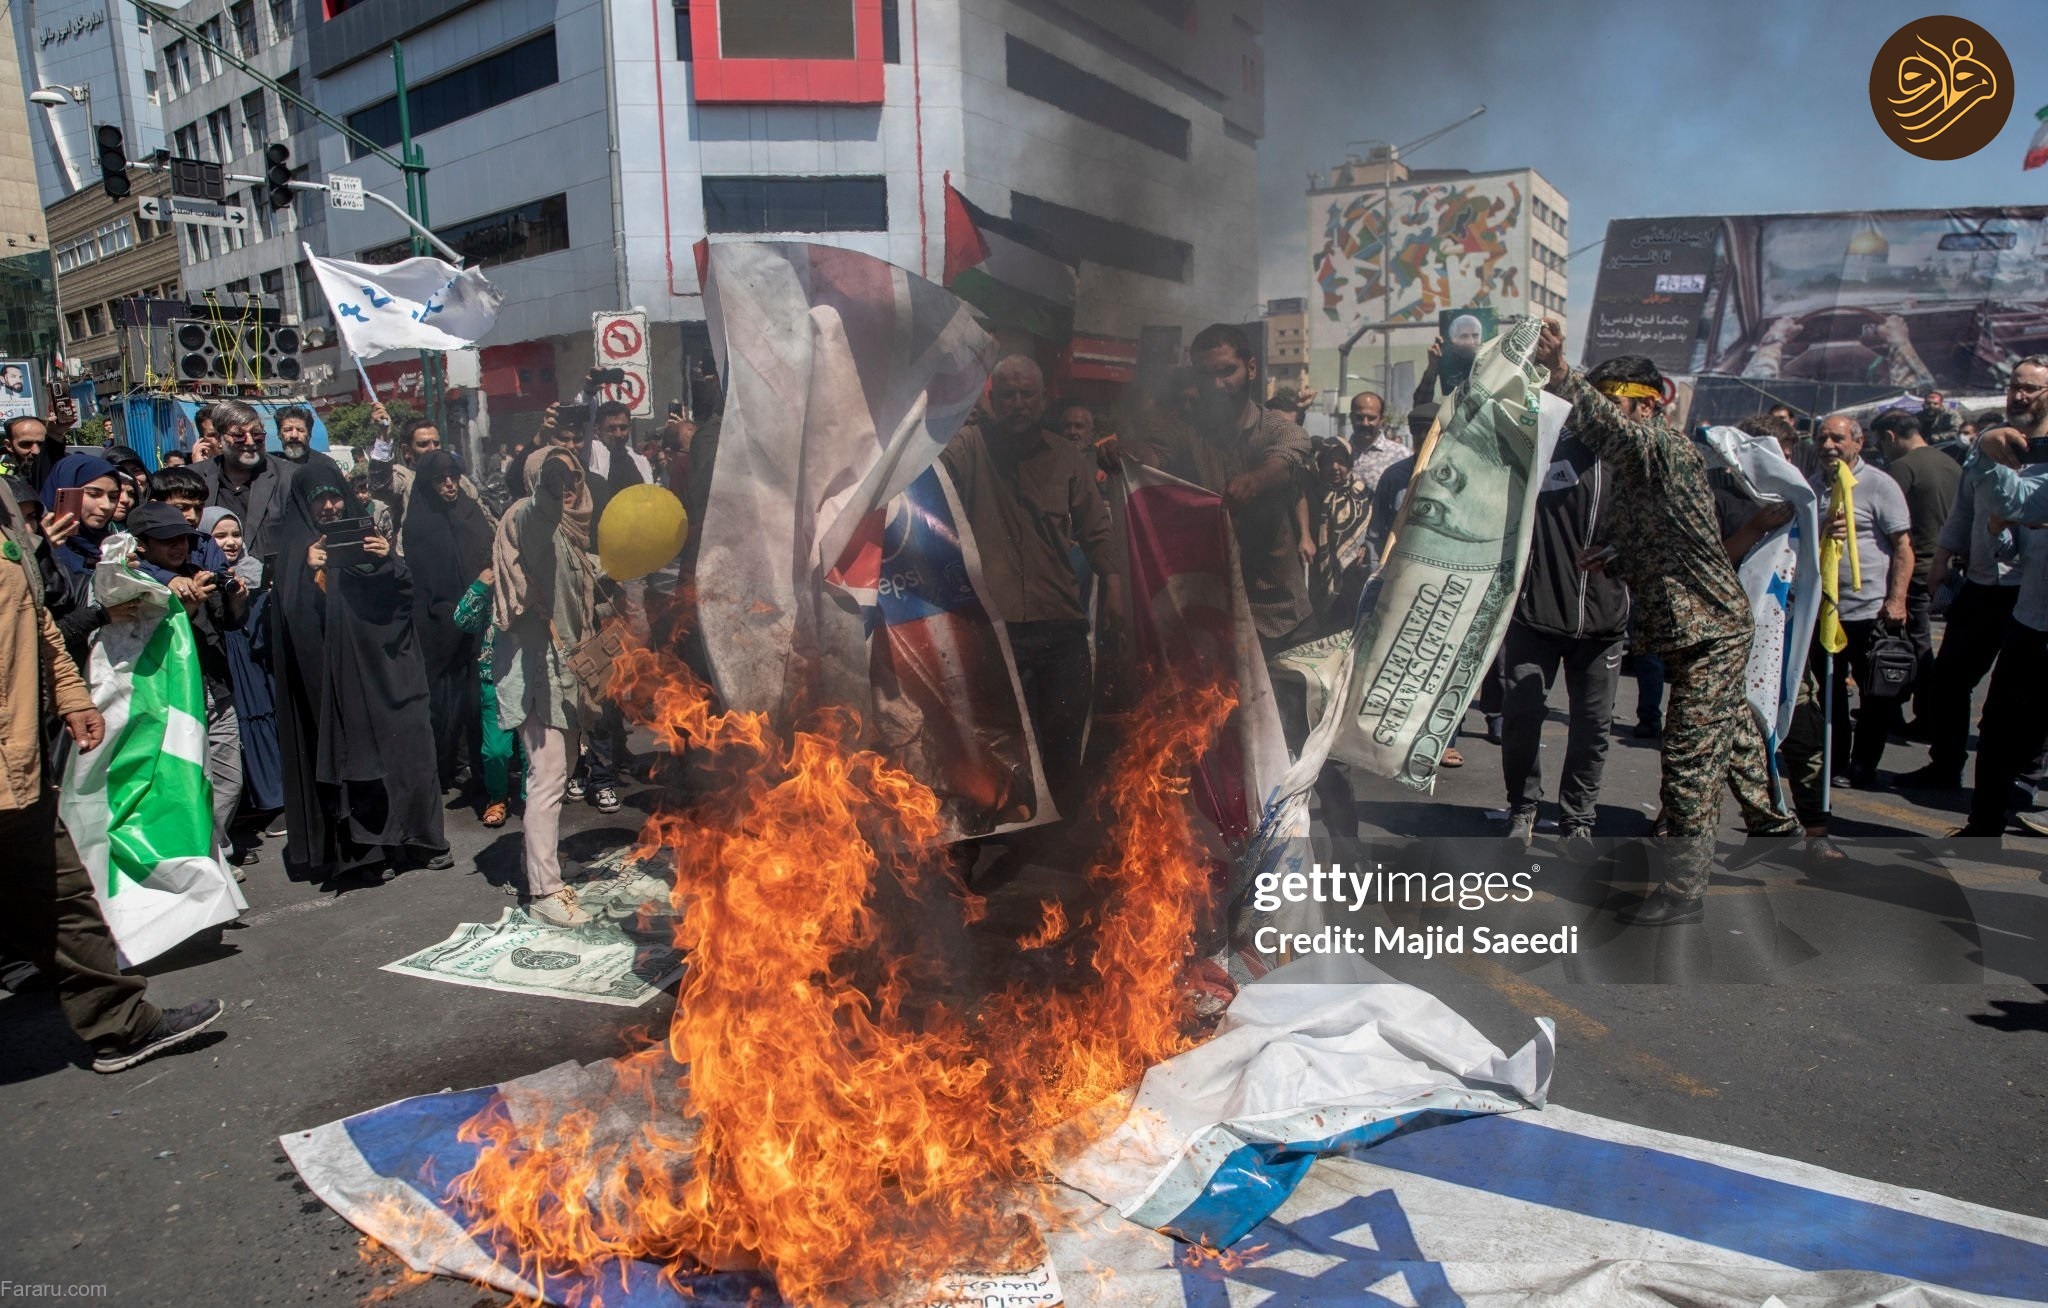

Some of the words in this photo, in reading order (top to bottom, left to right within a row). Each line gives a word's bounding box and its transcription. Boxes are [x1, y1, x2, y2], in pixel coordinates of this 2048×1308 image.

[878, 567, 925, 600] epsi
[1415, 574, 1472, 662] UNITED
[1373, 661, 1431, 747] STATES
